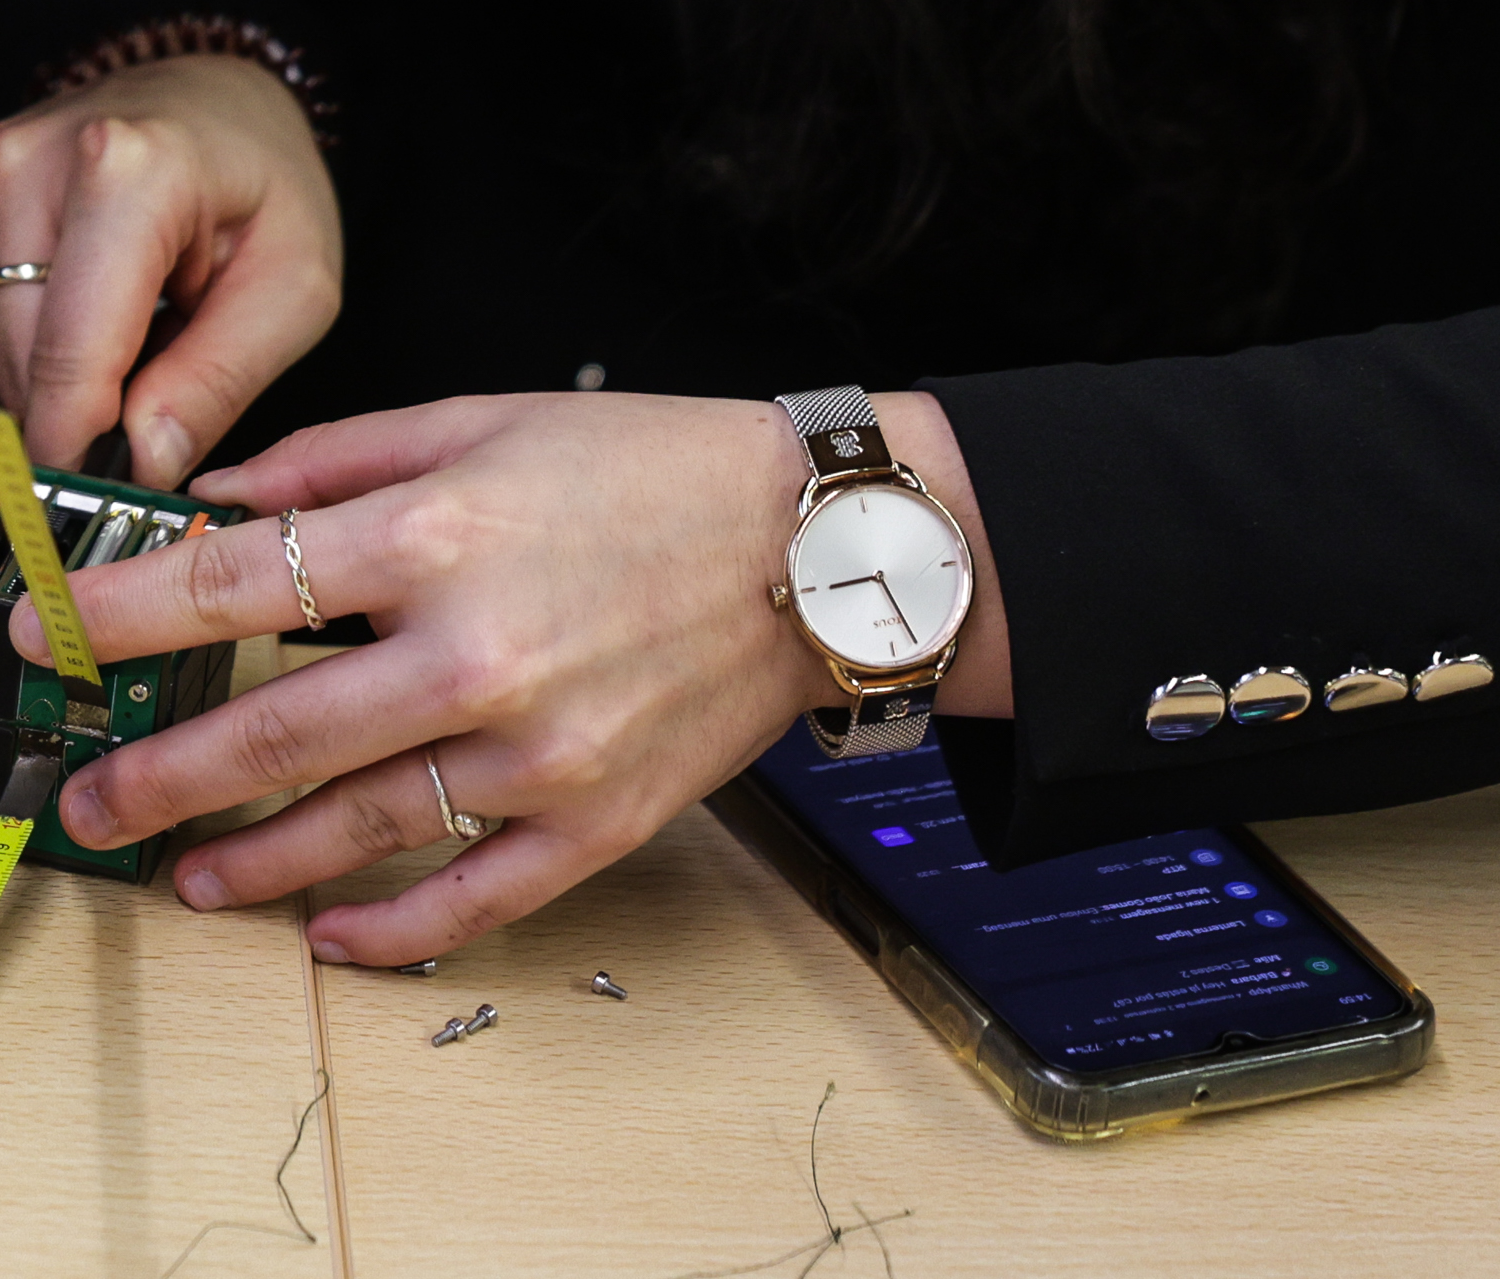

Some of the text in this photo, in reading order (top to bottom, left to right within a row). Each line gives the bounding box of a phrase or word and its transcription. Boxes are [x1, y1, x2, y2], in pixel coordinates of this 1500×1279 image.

[873, 616, 902, 629] TOUS
[1145, 892, 1173, 904] João
[1175, 886, 1211, 898] Maria
[1119, 902, 1185, 920] mensagem
[1155, 919, 1247, 941] Lanterna ligada
[1253, 953, 1283, 965] Mãe
[1230, 970, 1279, 985] Bárbara
[1155, 985, 1189, 999] estás
[1202, 979, 1227, 991] Hey
[1249, 981, 1309, 997] WhatsApp
[1135, 990, 1155, 1004] por
[1338, 992, 1373, 1006] 14:59
